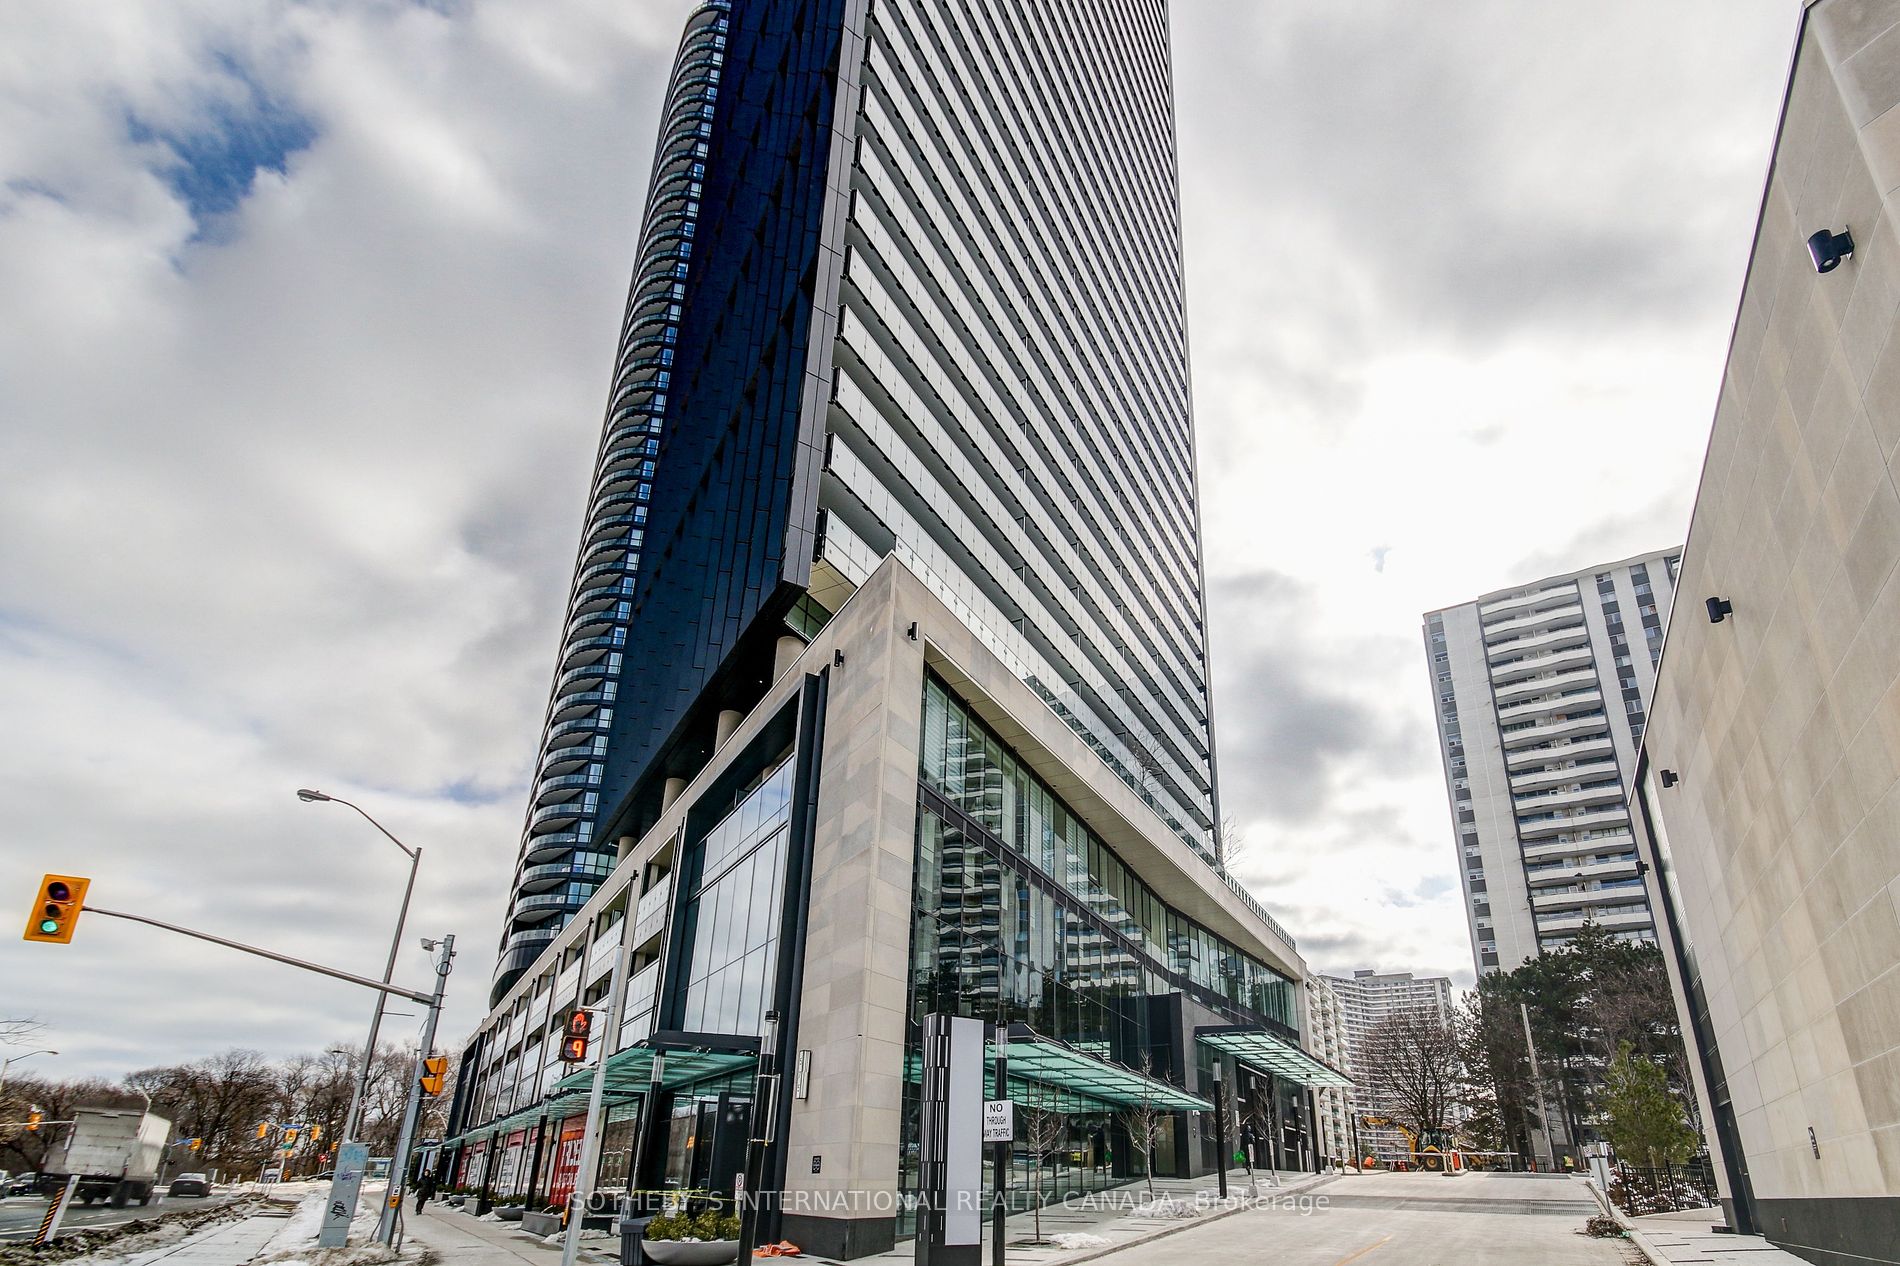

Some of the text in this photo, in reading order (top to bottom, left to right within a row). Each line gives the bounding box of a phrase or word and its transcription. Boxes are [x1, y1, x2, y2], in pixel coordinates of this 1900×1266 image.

[573, 1040, 583, 1057] 9
[989, 1103, 1003, 1112] NO
[986, 1115, 1007, 1125] THROUGH
[993, 1128, 1010, 1137] TRAFFIC
